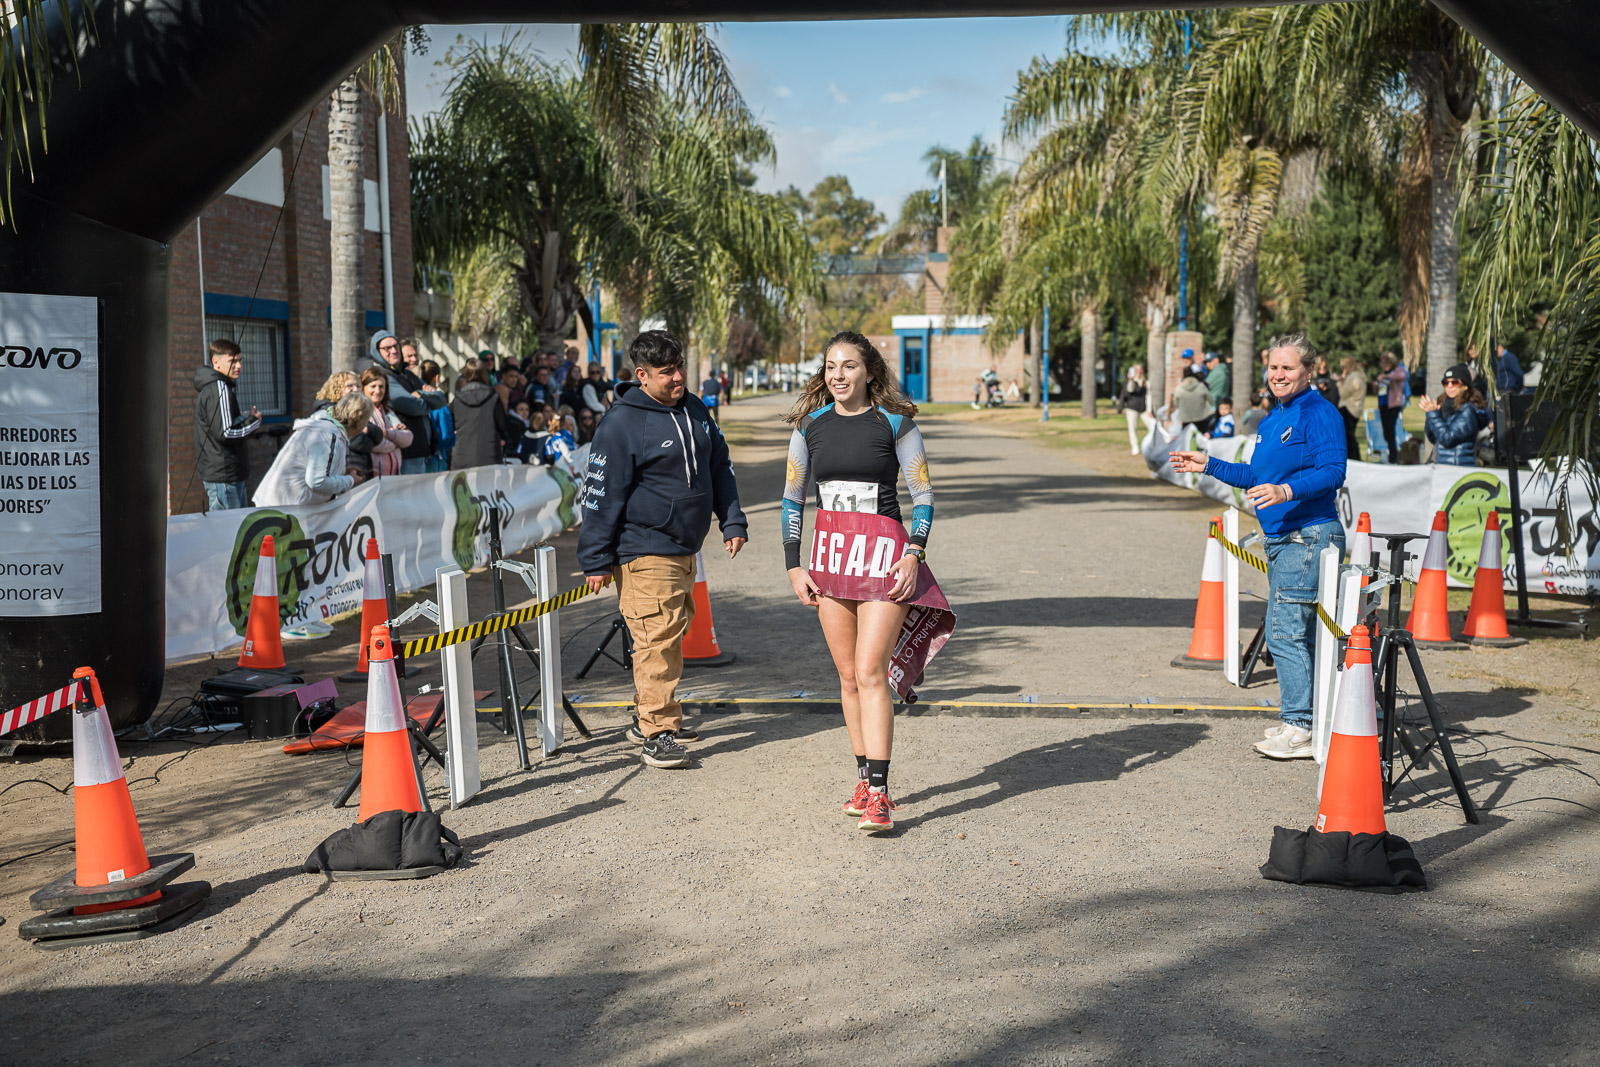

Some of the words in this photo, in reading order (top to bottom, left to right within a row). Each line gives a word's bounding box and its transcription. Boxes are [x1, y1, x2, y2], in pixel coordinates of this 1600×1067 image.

[0, 451, 60, 466] EJORAR
[64, 452, 90, 466] LAS
[28, 476, 47, 490] DE
[51, 476, 77, 490] LOS
[832, 494, 860, 512] 61
[900, 647, 914, 664] LO
